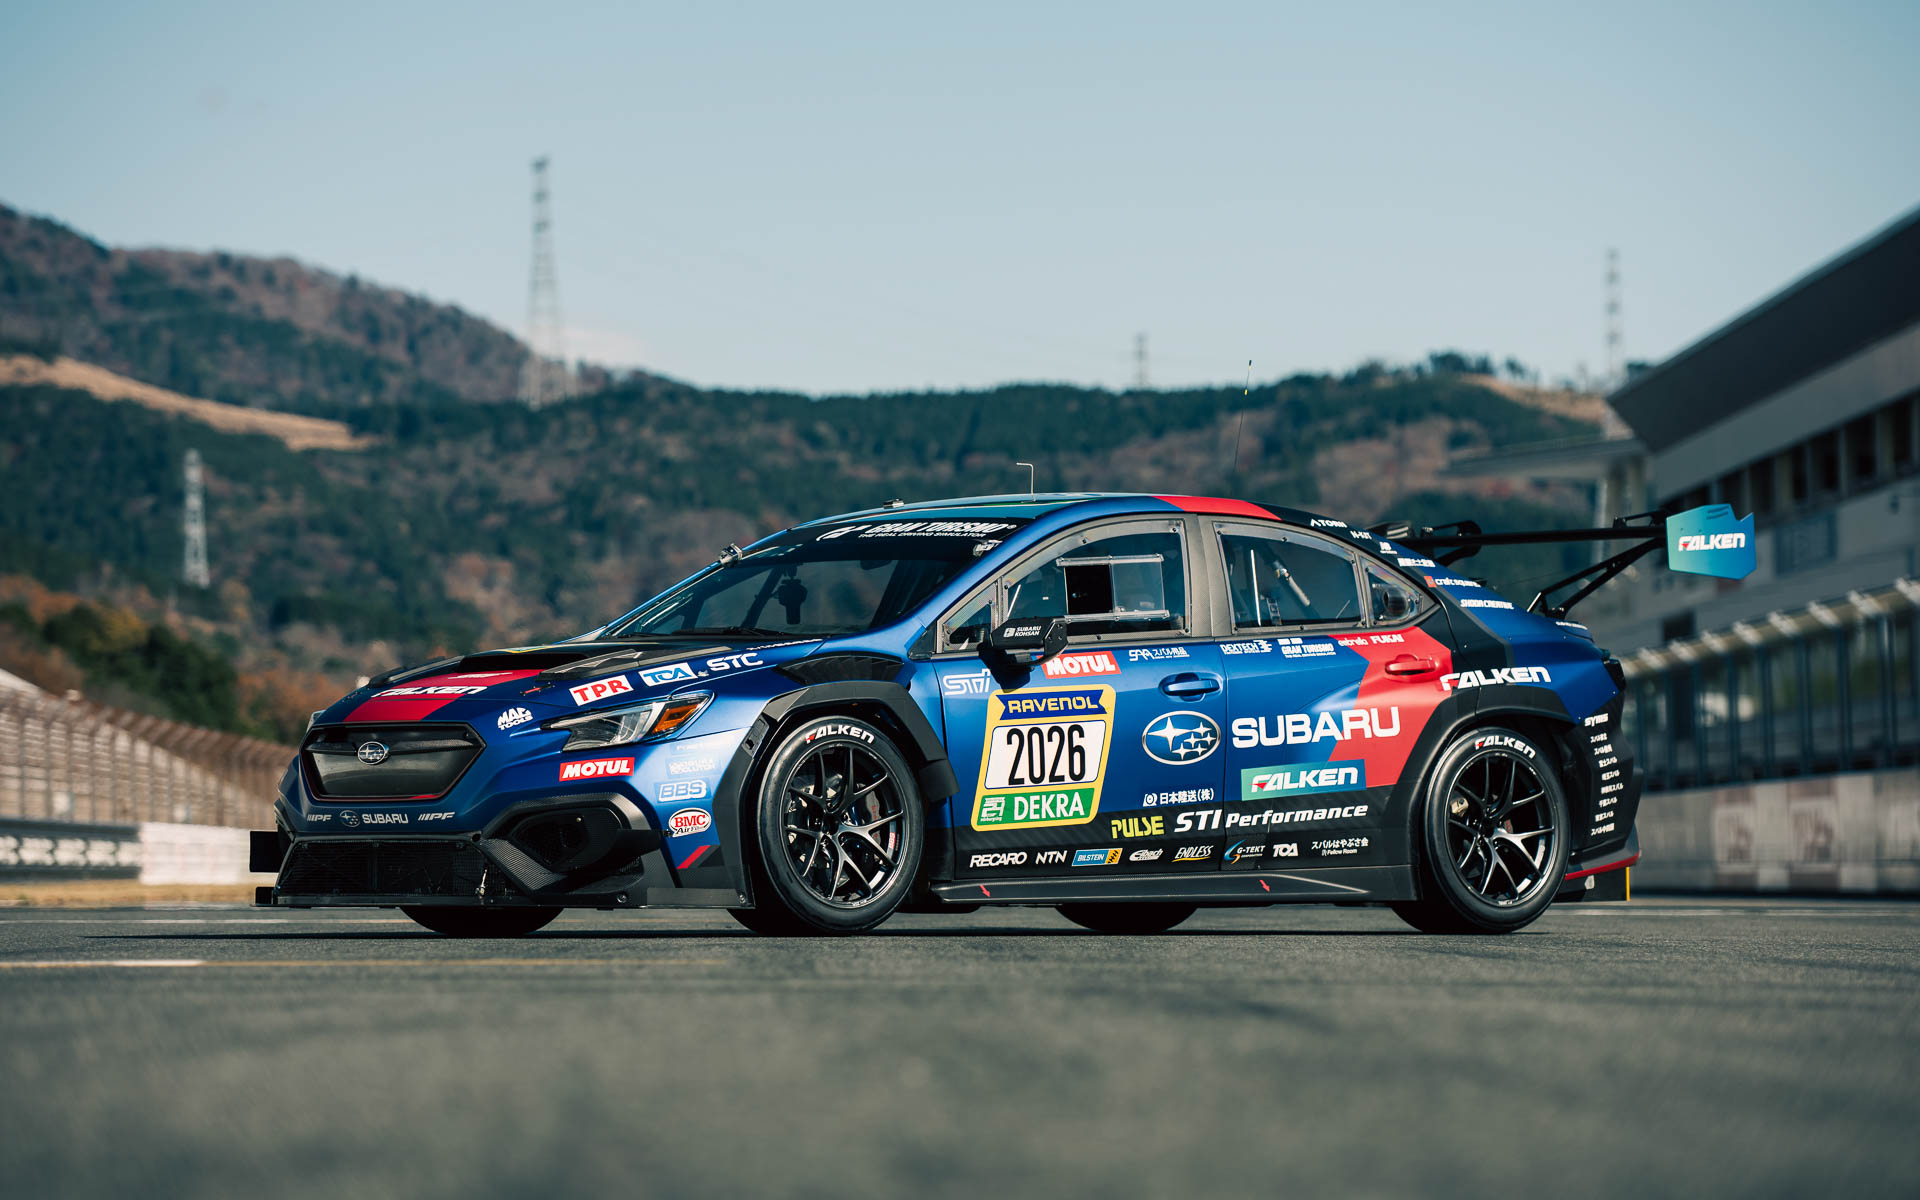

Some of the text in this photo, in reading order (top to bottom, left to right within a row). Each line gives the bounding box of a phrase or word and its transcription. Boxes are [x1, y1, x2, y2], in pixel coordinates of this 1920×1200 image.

[1678, 533, 1746, 552] FALKEN
[1282, 645, 1303, 655] GRAN
[706, 653, 763, 672] STC
[1043, 654, 1116, 676] MOTUL
[1440, 666, 1551, 691] FALKEN
[573, 680, 629, 702] TPR
[1007, 696, 1099, 713] RAVENOL
[497, 707, 532, 725] MAC
[498, 716, 533, 731] TOOLS
[805, 725, 875, 744] FALKEN
[1232, 706, 1401, 749] SUBARU
[1006, 724, 1086, 785] 2026
[1475, 735, 1536, 759] FALKEN
[562, 760, 631, 779] MOTUL
[1250, 766, 1358, 793] FALKEN
[658, 780, 706, 801] BBS
[1013, 792, 1085, 821] DEKRA
[362, 814, 409, 824] SUBARU
[674, 814, 706, 828] BMC
[1111, 816, 1165, 839] PULSE
[1174, 805, 1369, 833] STI Performance
[969, 852, 1028, 868] RECARO
[1035, 850, 1067, 865] NTN
[1077, 853, 1105, 862] BILSTEIN
[1175, 845, 1214, 859] ENDLESS
[1273, 843, 1299, 858] TOA
